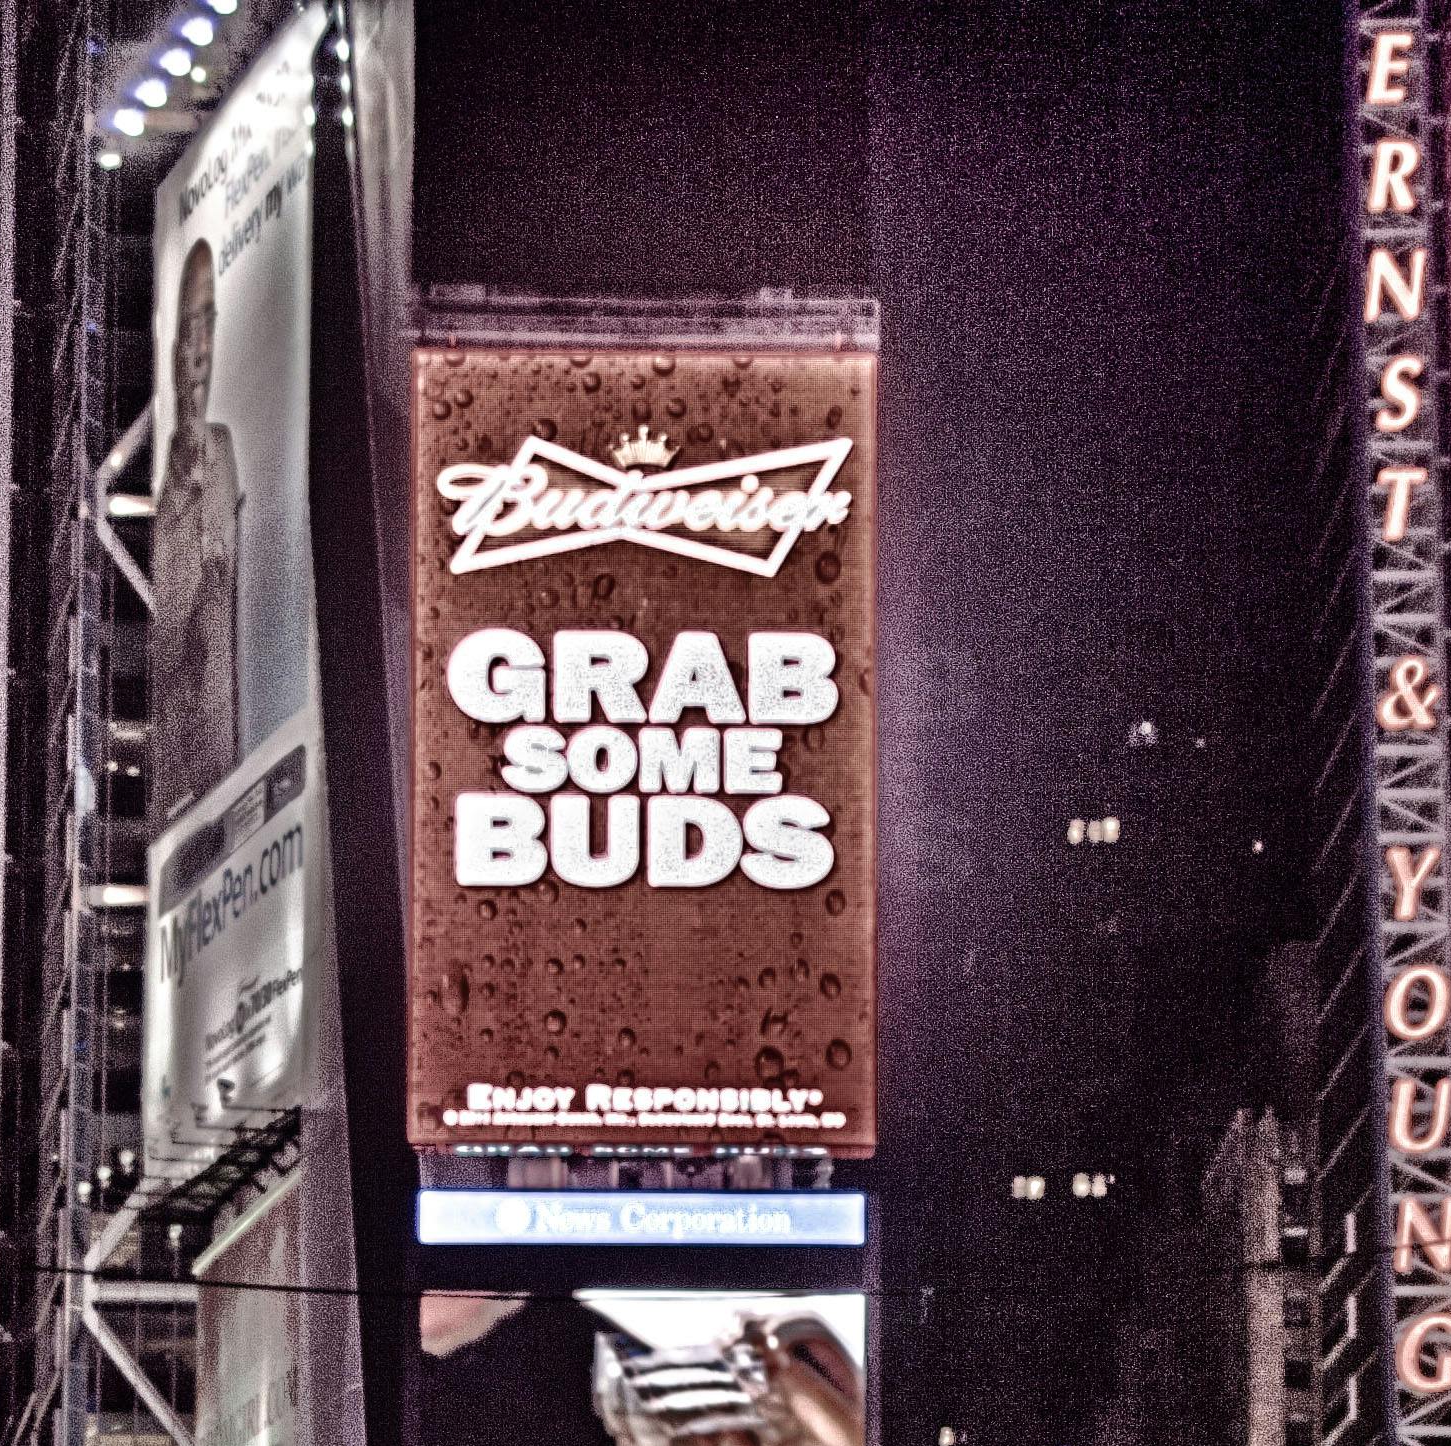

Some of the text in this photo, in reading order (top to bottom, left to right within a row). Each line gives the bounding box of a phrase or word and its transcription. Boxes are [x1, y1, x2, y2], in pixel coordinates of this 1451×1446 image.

[1364, 32, 1427, 543] ERNST
[437, 464, 849, 538] Budweiser
[446, 627, 840, 727] GRAB
[1377, 656, 1439, 730] &
[501, 726, 784, 796] SOME
[452, 791, 837, 890] BUDS
[535, 1199, 792, 1239] News Corporation
